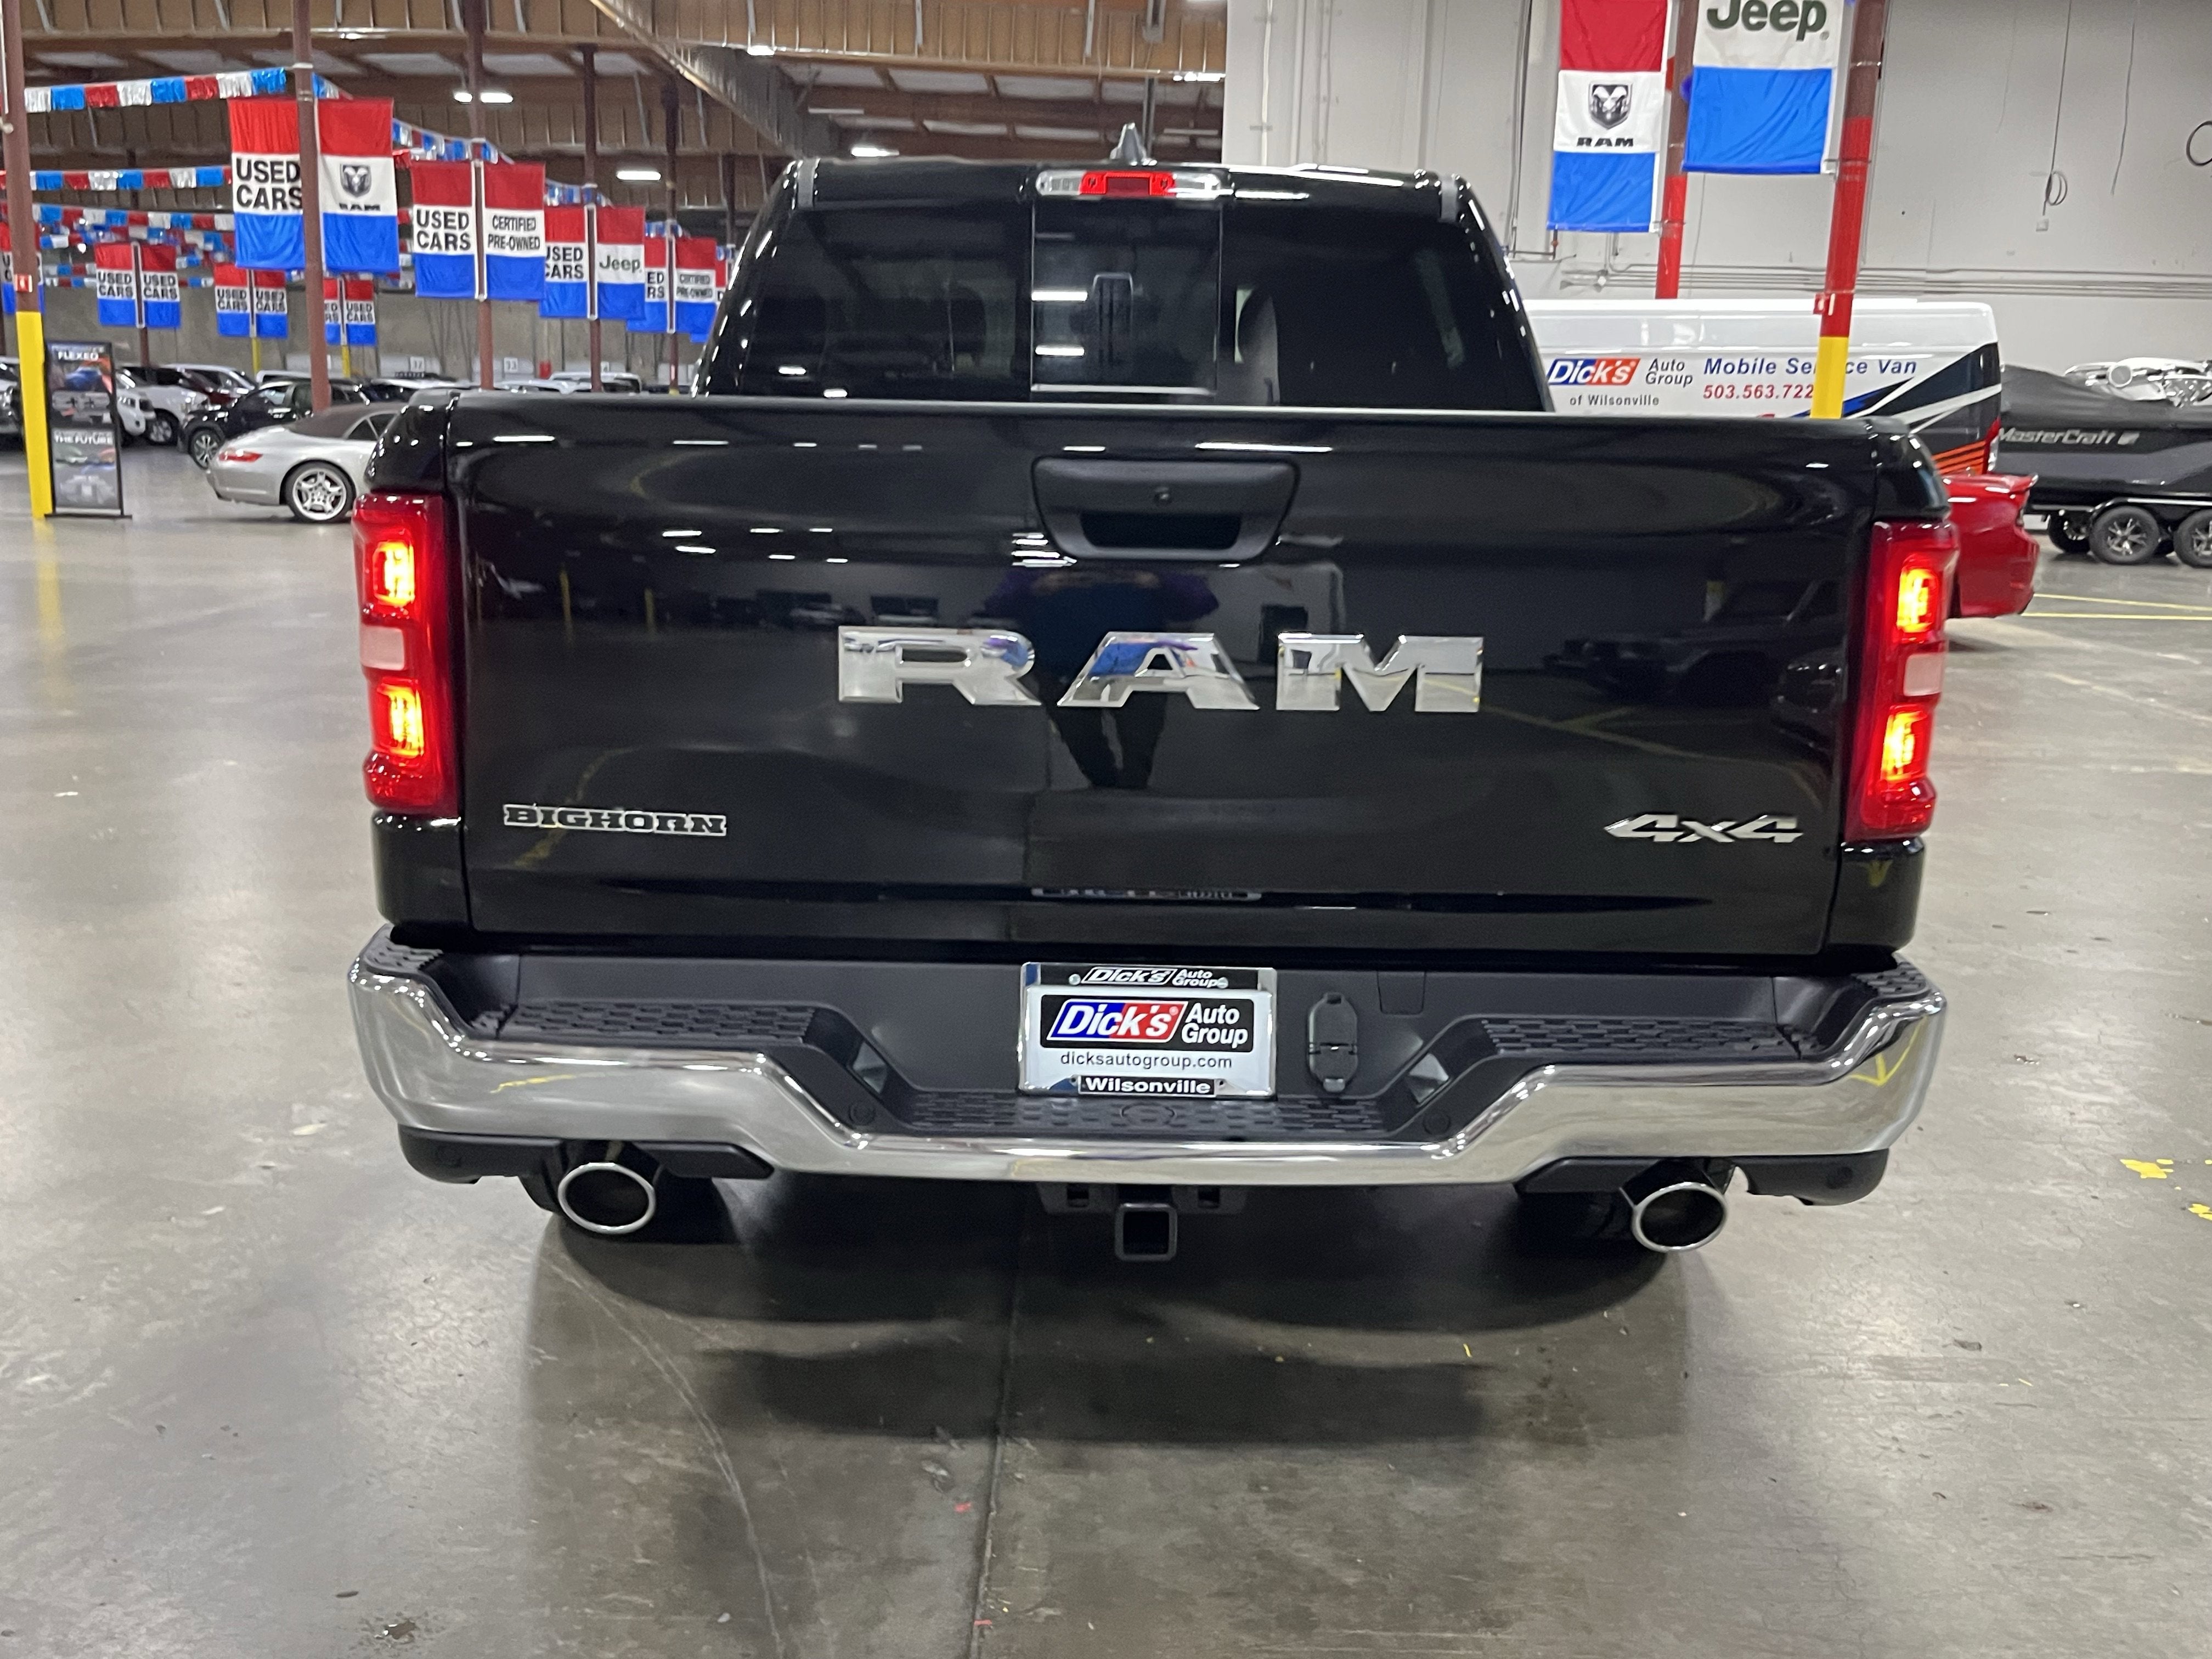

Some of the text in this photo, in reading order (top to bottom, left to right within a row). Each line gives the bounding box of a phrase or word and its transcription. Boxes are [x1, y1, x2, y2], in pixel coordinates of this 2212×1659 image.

[1707, 0, 1827, 42] Jeep
[1576, 137, 1634, 147] RAM
[236, 157, 301, 183] USED
[236, 184, 302, 210] CARS
[416, 209, 470, 230] USED
[492, 215, 537, 232] CERTIFIED
[416, 230, 471, 251] CARS
[488, 234, 540, 250] PRE-OWNED
[599, 255, 641, 273] Jeep
[98, 271, 132, 285] USED
[144, 274, 176, 286] USED
[647, 271, 664, 284] ED
[98, 285, 133, 298] CARS
[143, 286, 177, 299] CARS
[217, 289, 247, 299] USED
[1548, 360, 1630, 384] Dick's
[1648, 358, 1685, 372] Auto
[1703, 357, 1917, 375] Mobile Sece Van
[1645, 371, 1694, 388] Group
[1702, 383, 1814, 399] 503.563.722
[1569, 394, 1660, 406] of Wilsonville
[1998, 427, 2116, 444] MasterCraft
[838, 625, 1485, 713] RAM
[503, 804, 727, 836] BIGHORN
[1603, 813, 1804, 843] 4x4
[1087, 969, 1170, 984] Dick's
[1176, 968, 1213, 979] Auto
[1172, 977, 1219, 988] Group
[1057, 1003, 1171, 1036] Dick's
[1184, 1002, 1240, 1025] Auto
[1181, 1022, 1249, 1049] Group
[1060, 1051, 1232, 1070] dicksautogroup.com
[1085, 1077, 1211, 1094] Wilsonville
